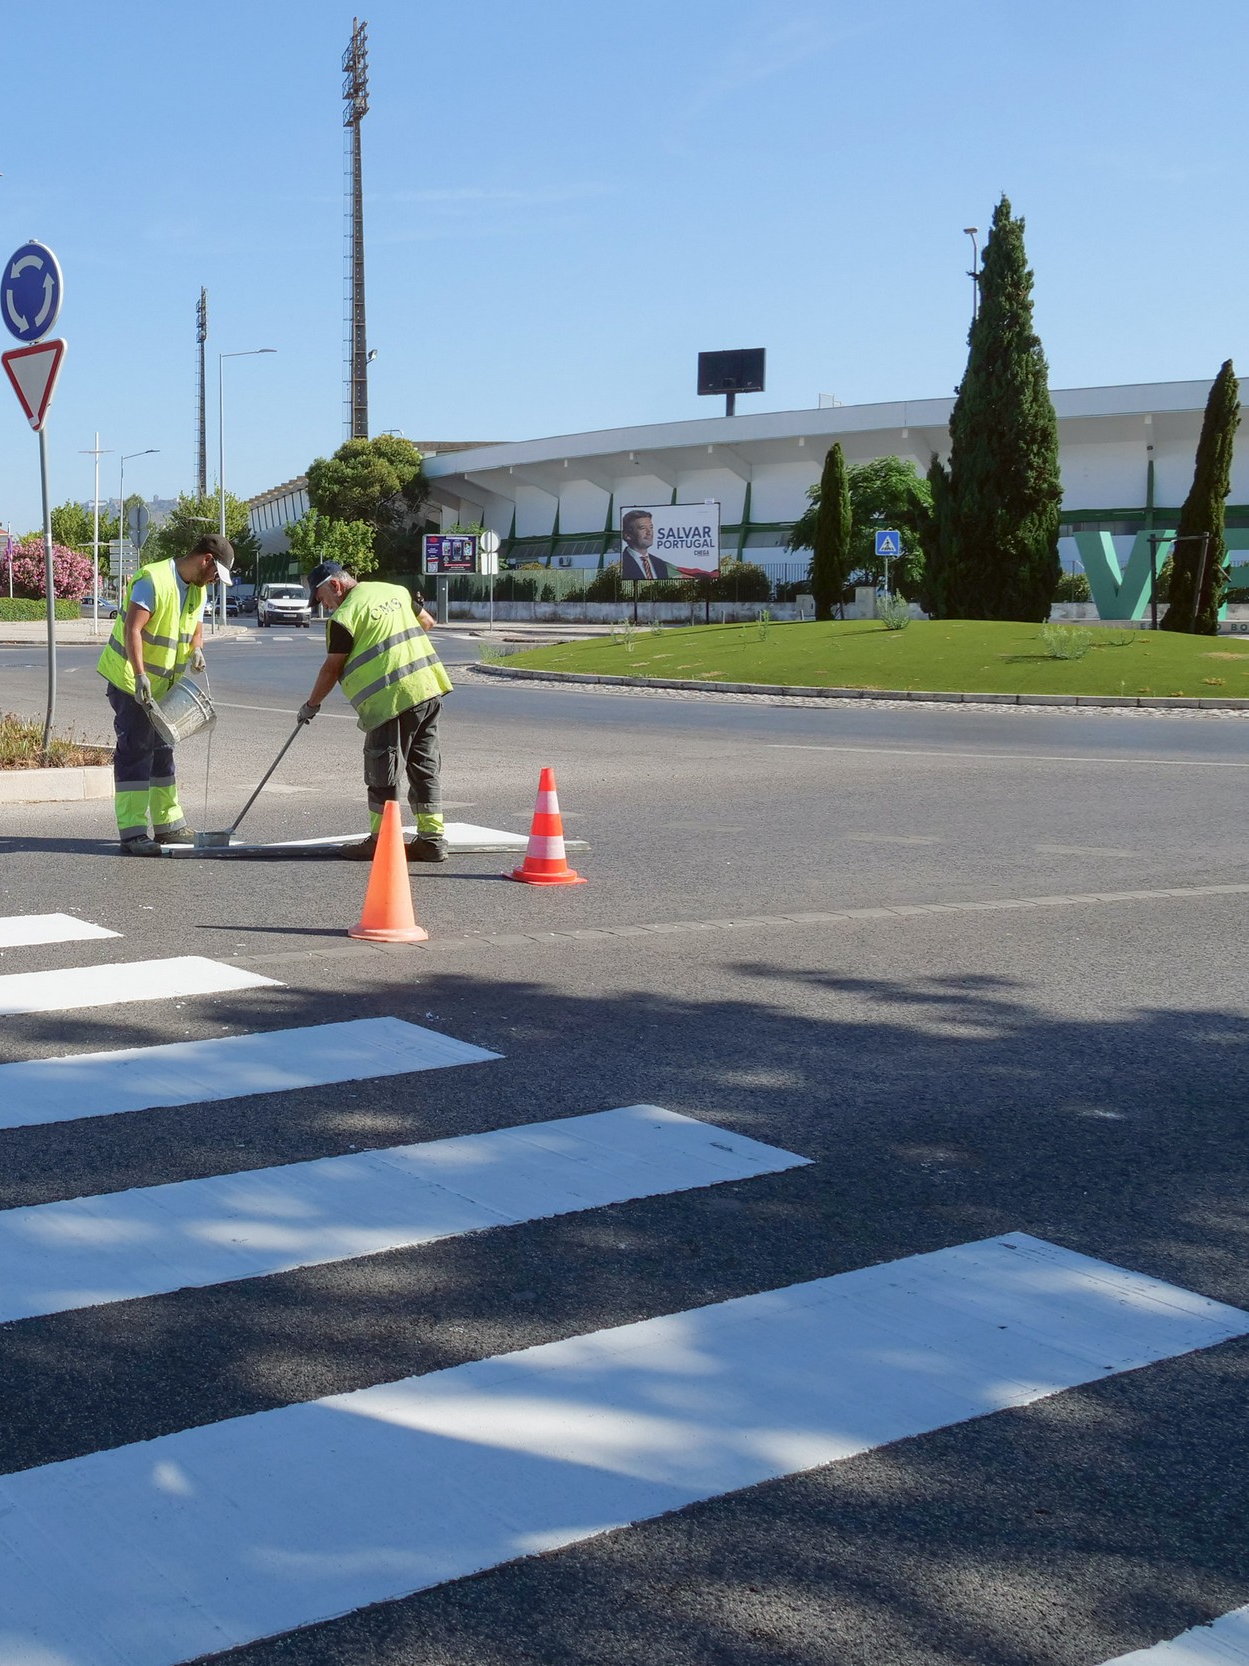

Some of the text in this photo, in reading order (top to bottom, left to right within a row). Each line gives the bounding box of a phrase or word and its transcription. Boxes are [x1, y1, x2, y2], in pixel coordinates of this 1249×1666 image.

[657, 526, 711, 540] SALVAR
[656, 538, 715, 550] PORTUGAL
[371, 597, 402, 620] CMS
